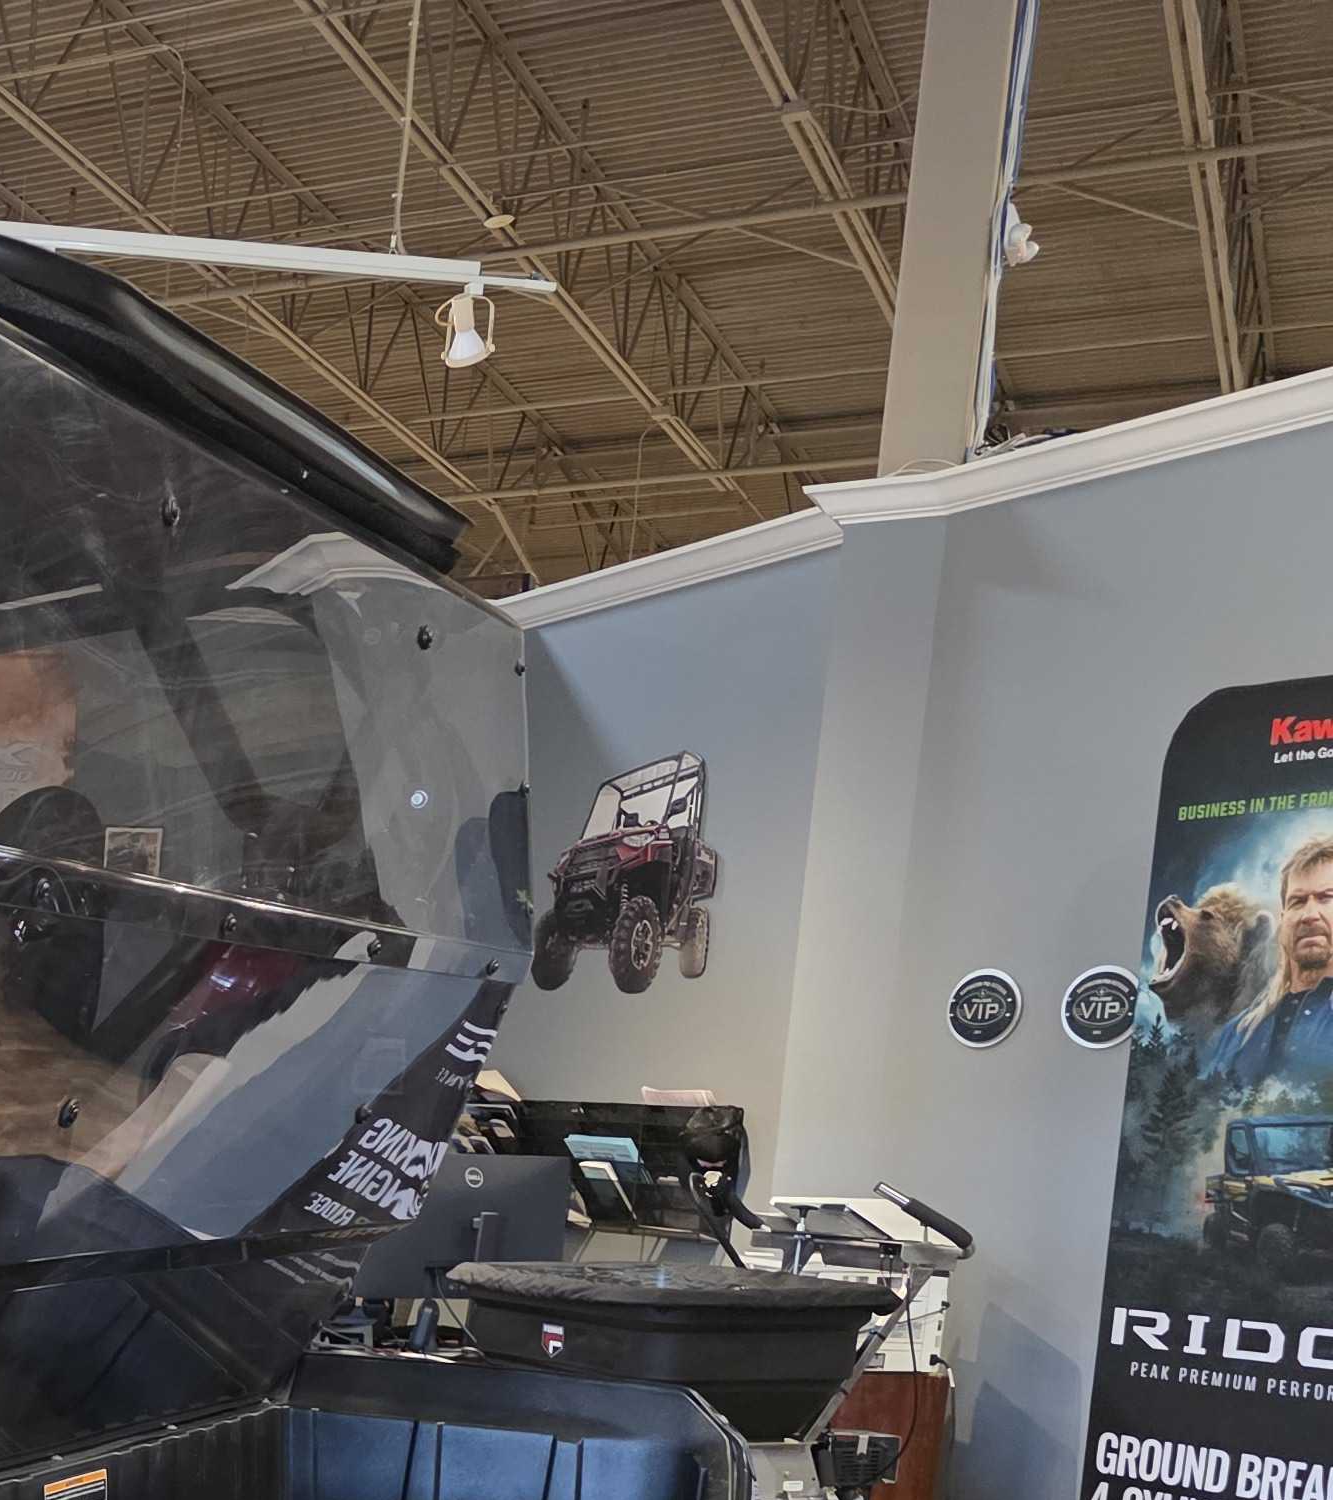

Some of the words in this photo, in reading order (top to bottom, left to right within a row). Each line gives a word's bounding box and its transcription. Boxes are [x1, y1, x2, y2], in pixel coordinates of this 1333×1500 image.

[1273, 750, 1294, 764] Let
[1295, 748, 1316, 762] the
[1178, 798, 1246, 821] BUSINESS
[1249, 797, 1265, 814] IN
[1268, 794, 1297, 812] THE
[963, 1002, 999, 1020] VIP
[1079, 1001, 1121, 1020] VIP
[1129, 1361, 1171, 1382] PEAK
[1178, 1367, 1257, 1392] PREMIUM
[1095, 1431, 1230, 1493] GROUND
